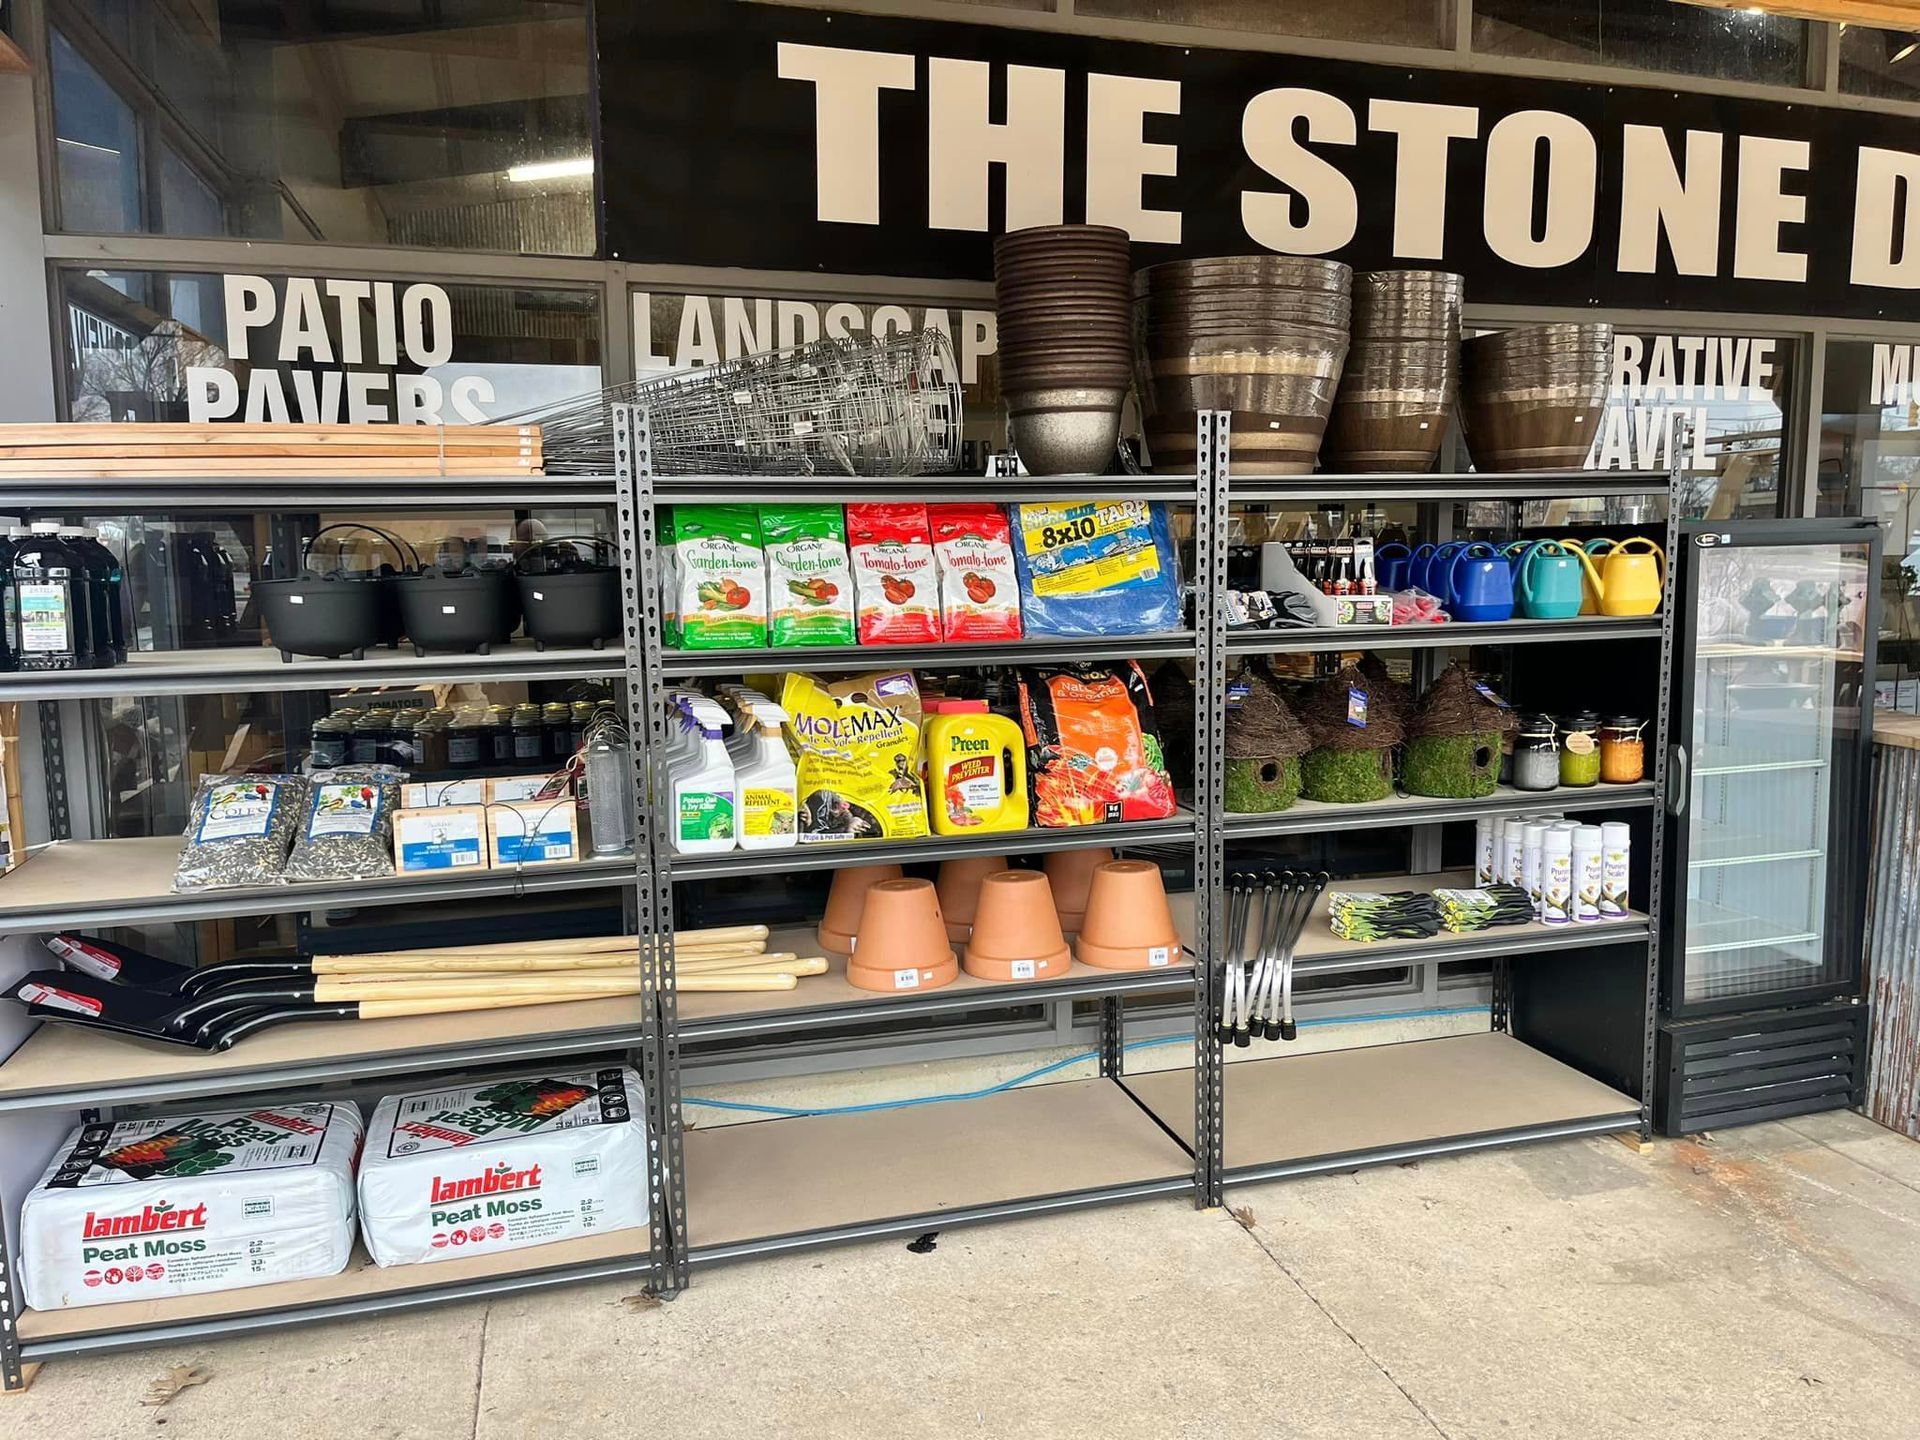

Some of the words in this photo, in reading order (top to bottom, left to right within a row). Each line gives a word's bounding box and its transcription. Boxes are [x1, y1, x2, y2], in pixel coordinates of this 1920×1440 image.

[777, 41, 1182, 244] THE
[1241, 87, 1810, 282] STONE
[224, 274, 452, 367] PATIO
[1611, 334, 1776, 401] RATIVE
[1870, 343, 1920, 405] M
[186, 367, 496, 425] PAVERS
[1096, 500, 1148, 526] TARP
[955, 541, 990, 550] ORGANIC
[1042, 517, 1096, 549] 8x10
[687, 550, 758, 570] Garden-tone
[700, 542, 740, 552] ORGANIC
[786, 543, 824, 553] ORGANIC
[873, 546, 911, 554] ORGANIC
[944, 549, 1007, 568] Tomato-tone
[776, 550, 842, 571] Garden-tone
[860, 552, 928, 571] Tomato-tone
[795, 705, 902, 740] MOLEMAX
[857, 728, 903, 744] Repellent
[876, 736, 909, 749] Granules
[951, 736, 989, 751] Preen
[952, 766, 990, 782] PREVENTER
[961, 760, 982, 771] WEED
[216, 1117, 294, 1145] Peat
[250, 1110, 326, 1136] lambert
[425, 1110, 503, 1136] Peat
[463, 1105, 545, 1133] Moss
[172, 1118, 250, 1147] Moss
[431, 1163, 542, 1204] lambert
[83, 1202, 207, 1238] lambert
[432, 1204, 482, 1227] Peat
[487, 1198, 543, 1217] Moss
[83, 1243, 138, 1263] Peat
[144, 1239, 206, 1256] Moss
